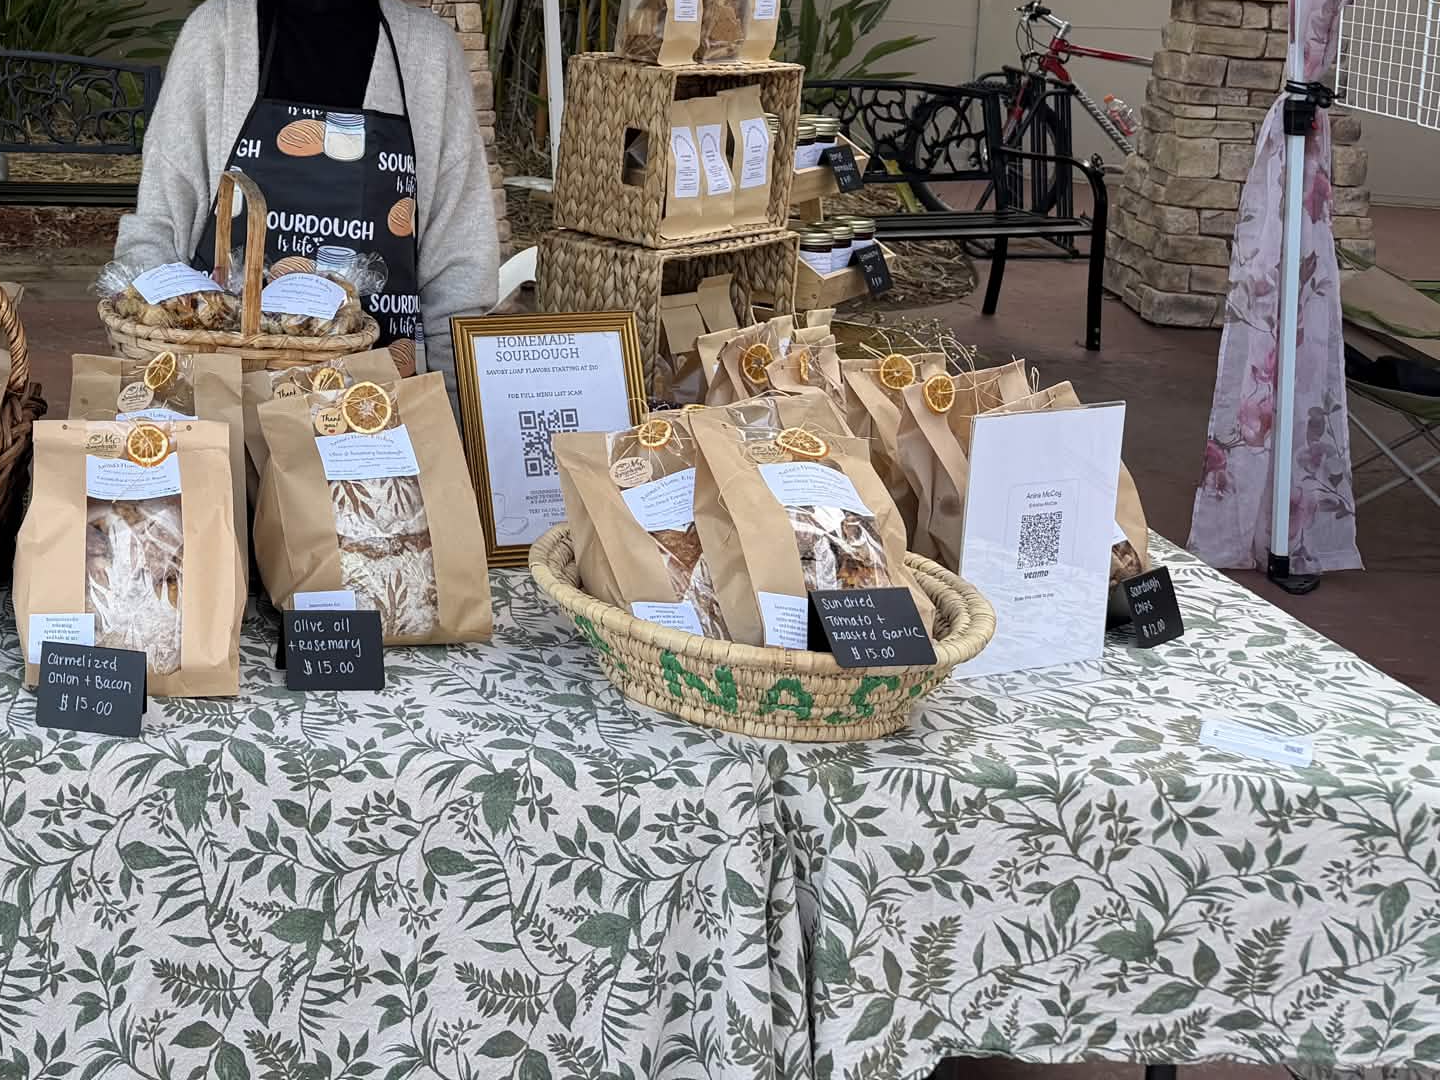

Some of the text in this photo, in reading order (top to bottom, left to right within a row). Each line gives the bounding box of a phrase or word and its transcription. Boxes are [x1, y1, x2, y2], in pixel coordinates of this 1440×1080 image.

[266, 211, 375, 241] OURDOUGH
[292, 235, 314, 256] life
[496, 334, 576, 348] HOMEMADE
[496, 347, 580, 362] SOURDOUGH
[276, 390, 298, 398] Thank
[321, 414, 341, 422] Thank
[1024, 570, 1049, 580] venmo
[294, 618, 324, 633] Olive
[825, 614, 872, 628] Tomato
[832, 626, 926, 641] Roasted Garlic
[47, 652, 118, 672] Carmelized
[48, 671, 80, 687] Onion
[95, 675, 132, 694] Bacon
